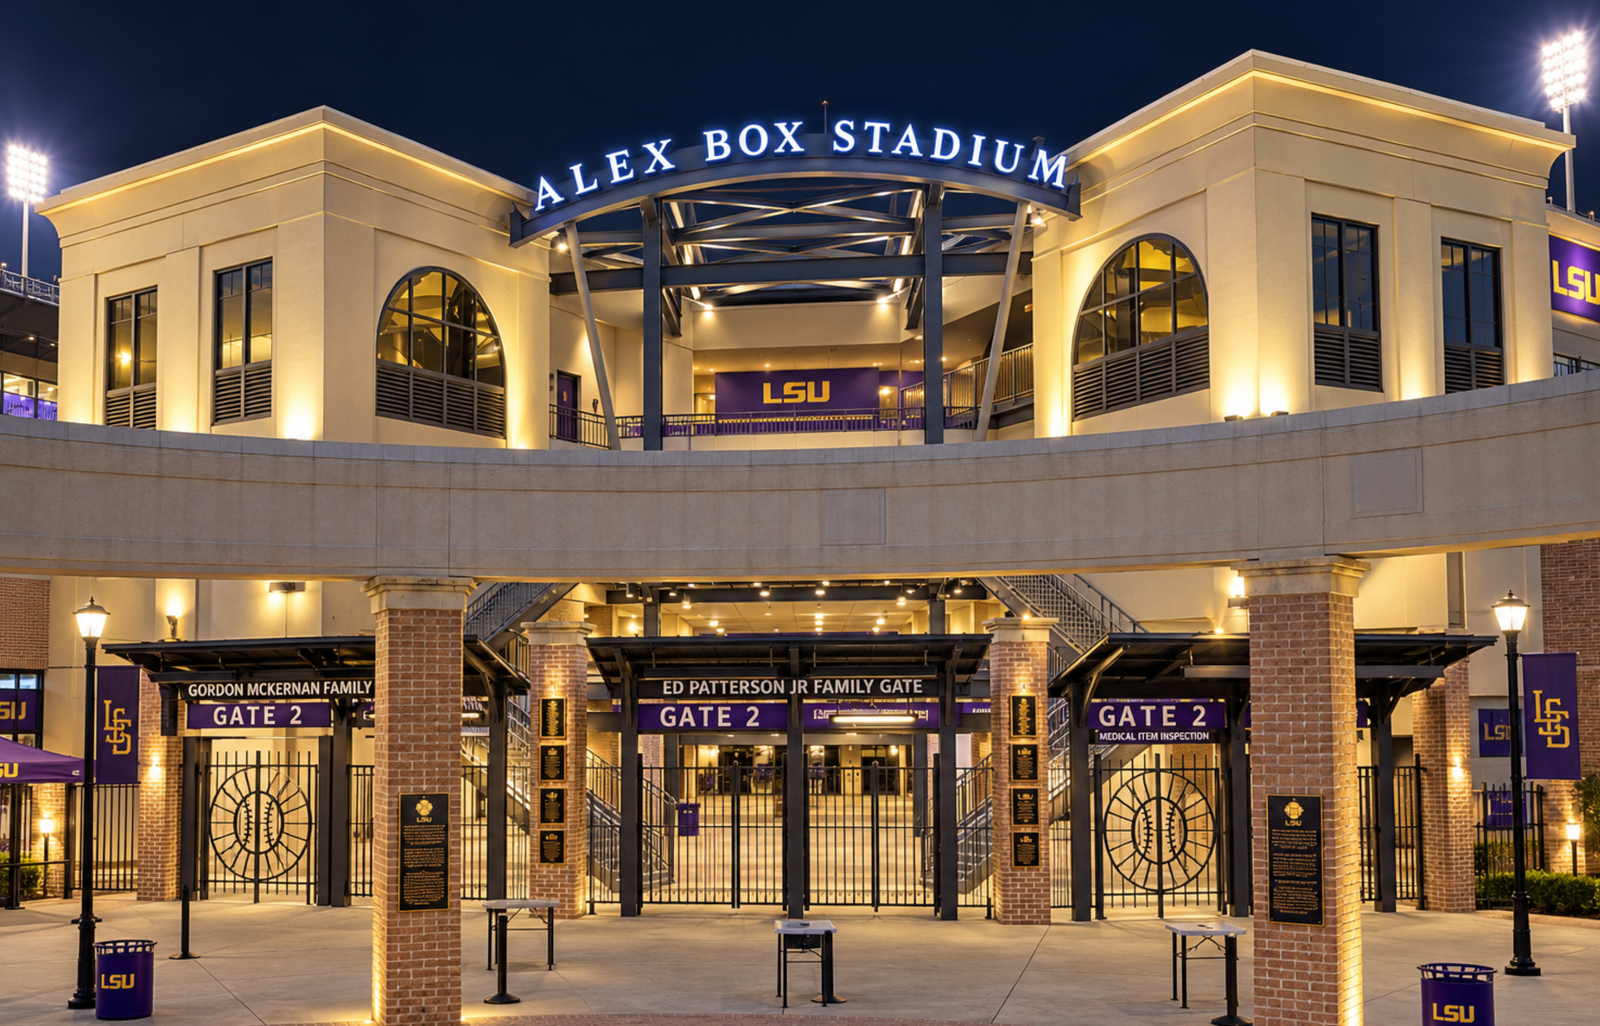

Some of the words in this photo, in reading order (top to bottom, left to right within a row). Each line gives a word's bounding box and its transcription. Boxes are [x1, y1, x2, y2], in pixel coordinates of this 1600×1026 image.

[534, 138, 676, 212] ALEX
[702, 121, 805, 162] BOX
[832, 119, 1068, 189] STADIUM
[1552, 259, 1600, 306] LSU
[762, 380, 830, 404] LSU
[188, 683, 244, 697] GORDON
[247, 681, 320, 696] MCKERNAN
[323, 680, 372, 695] FAMILY
[662, 680, 684, 695] ED
[689, 680, 785, 695] PATTERSON
[789, 679, 808, 695] JR
[813, 679, 874, 694] FAMILY
[879, 679, 923, 694] GATE
[213, 706, 276, 726] GATE
[290, 706, 302, 725] 2
[660, 706, 732, 727] GATE
[746, 706, 760, 727] 2
[1098, 705, 1177, 727] GATE
[1192, 705, 1207, 727] 2
[1099, 732, 1136, 740] MEDICAL
[1138, 732, 1158, 740] ITEM
[1160, 731, 1210, 740] INSPECTION
[101, 973, 135, 989] LSU
[1432, 1002, 1475, 1023] LSU
